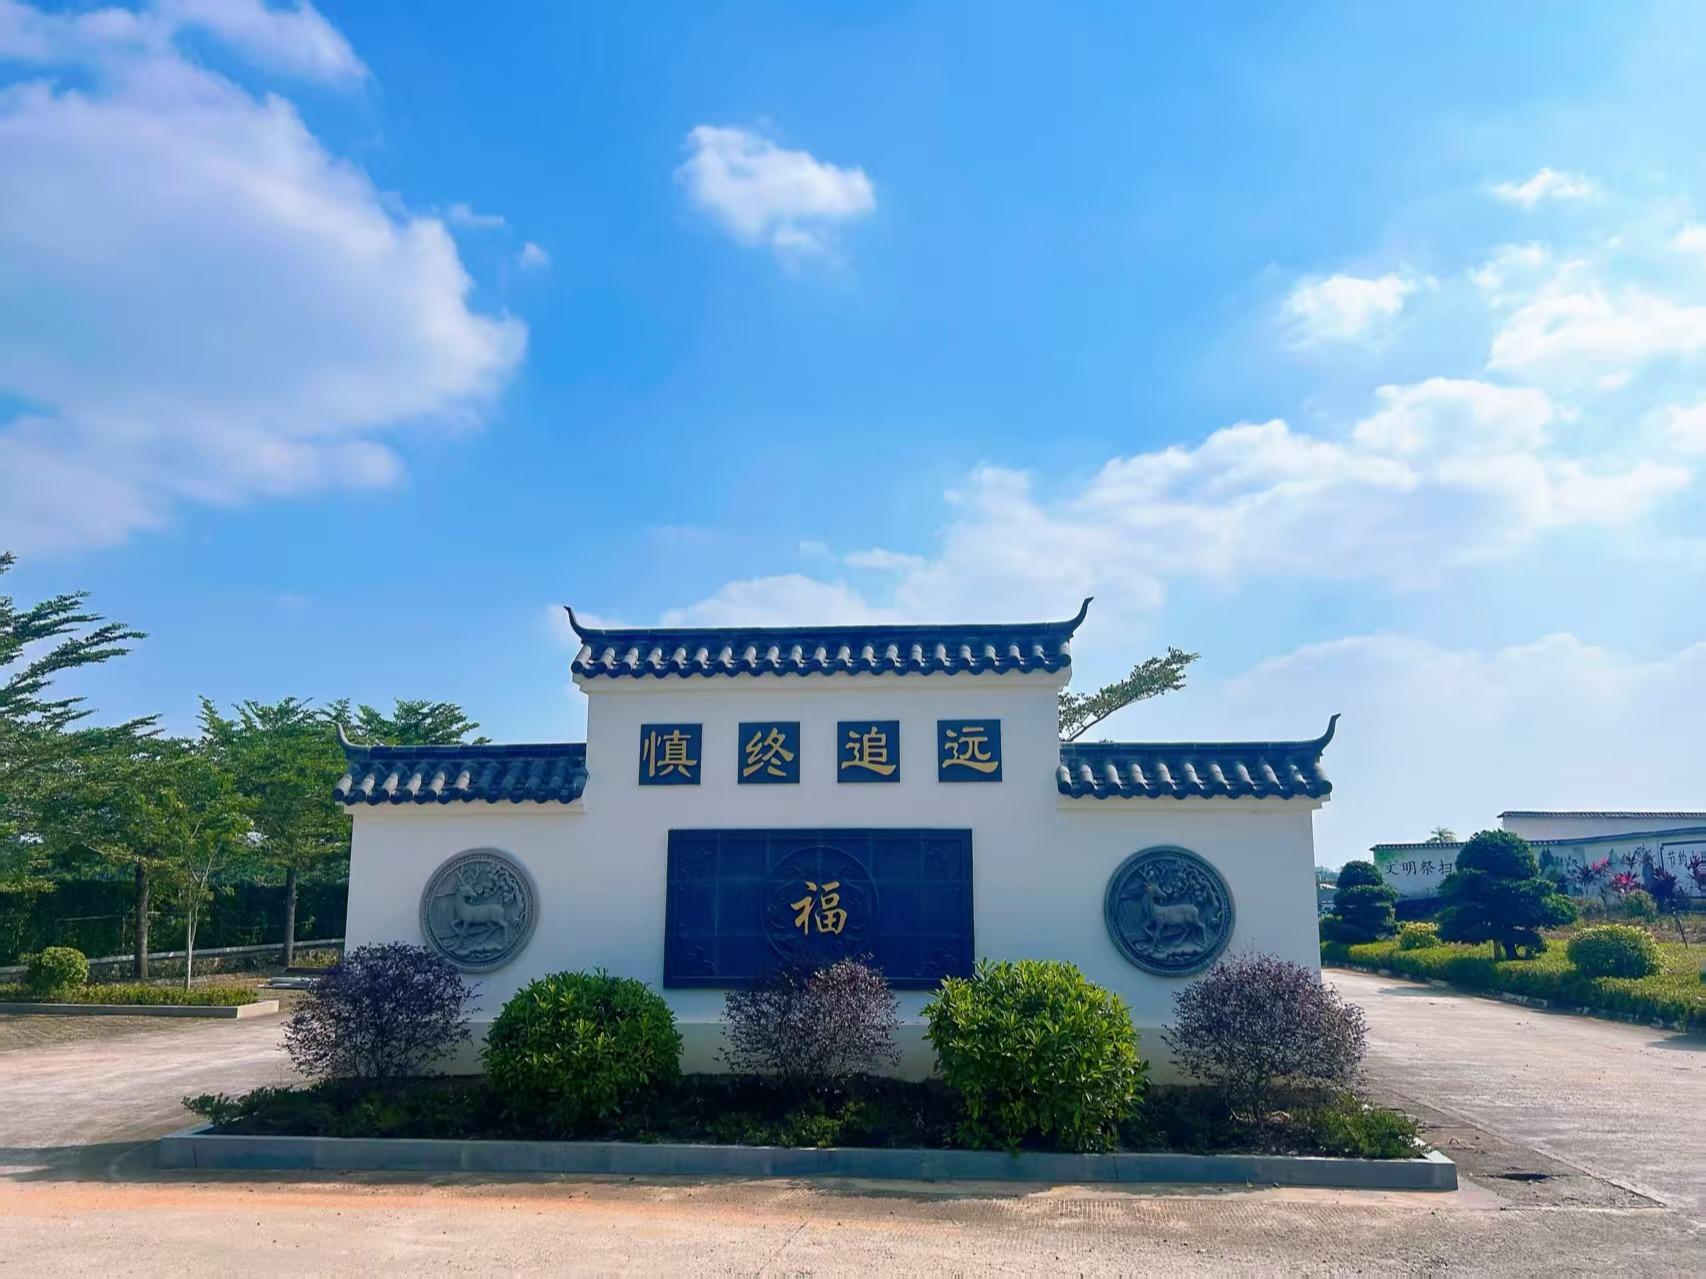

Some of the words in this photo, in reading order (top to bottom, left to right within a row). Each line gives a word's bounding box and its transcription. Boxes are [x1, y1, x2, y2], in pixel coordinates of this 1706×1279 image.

[643, 726, 999, 778] 慎终追远
[1385, 860, 1453, 876] 文明祭扫
[790, 881, 848, 936] 福
